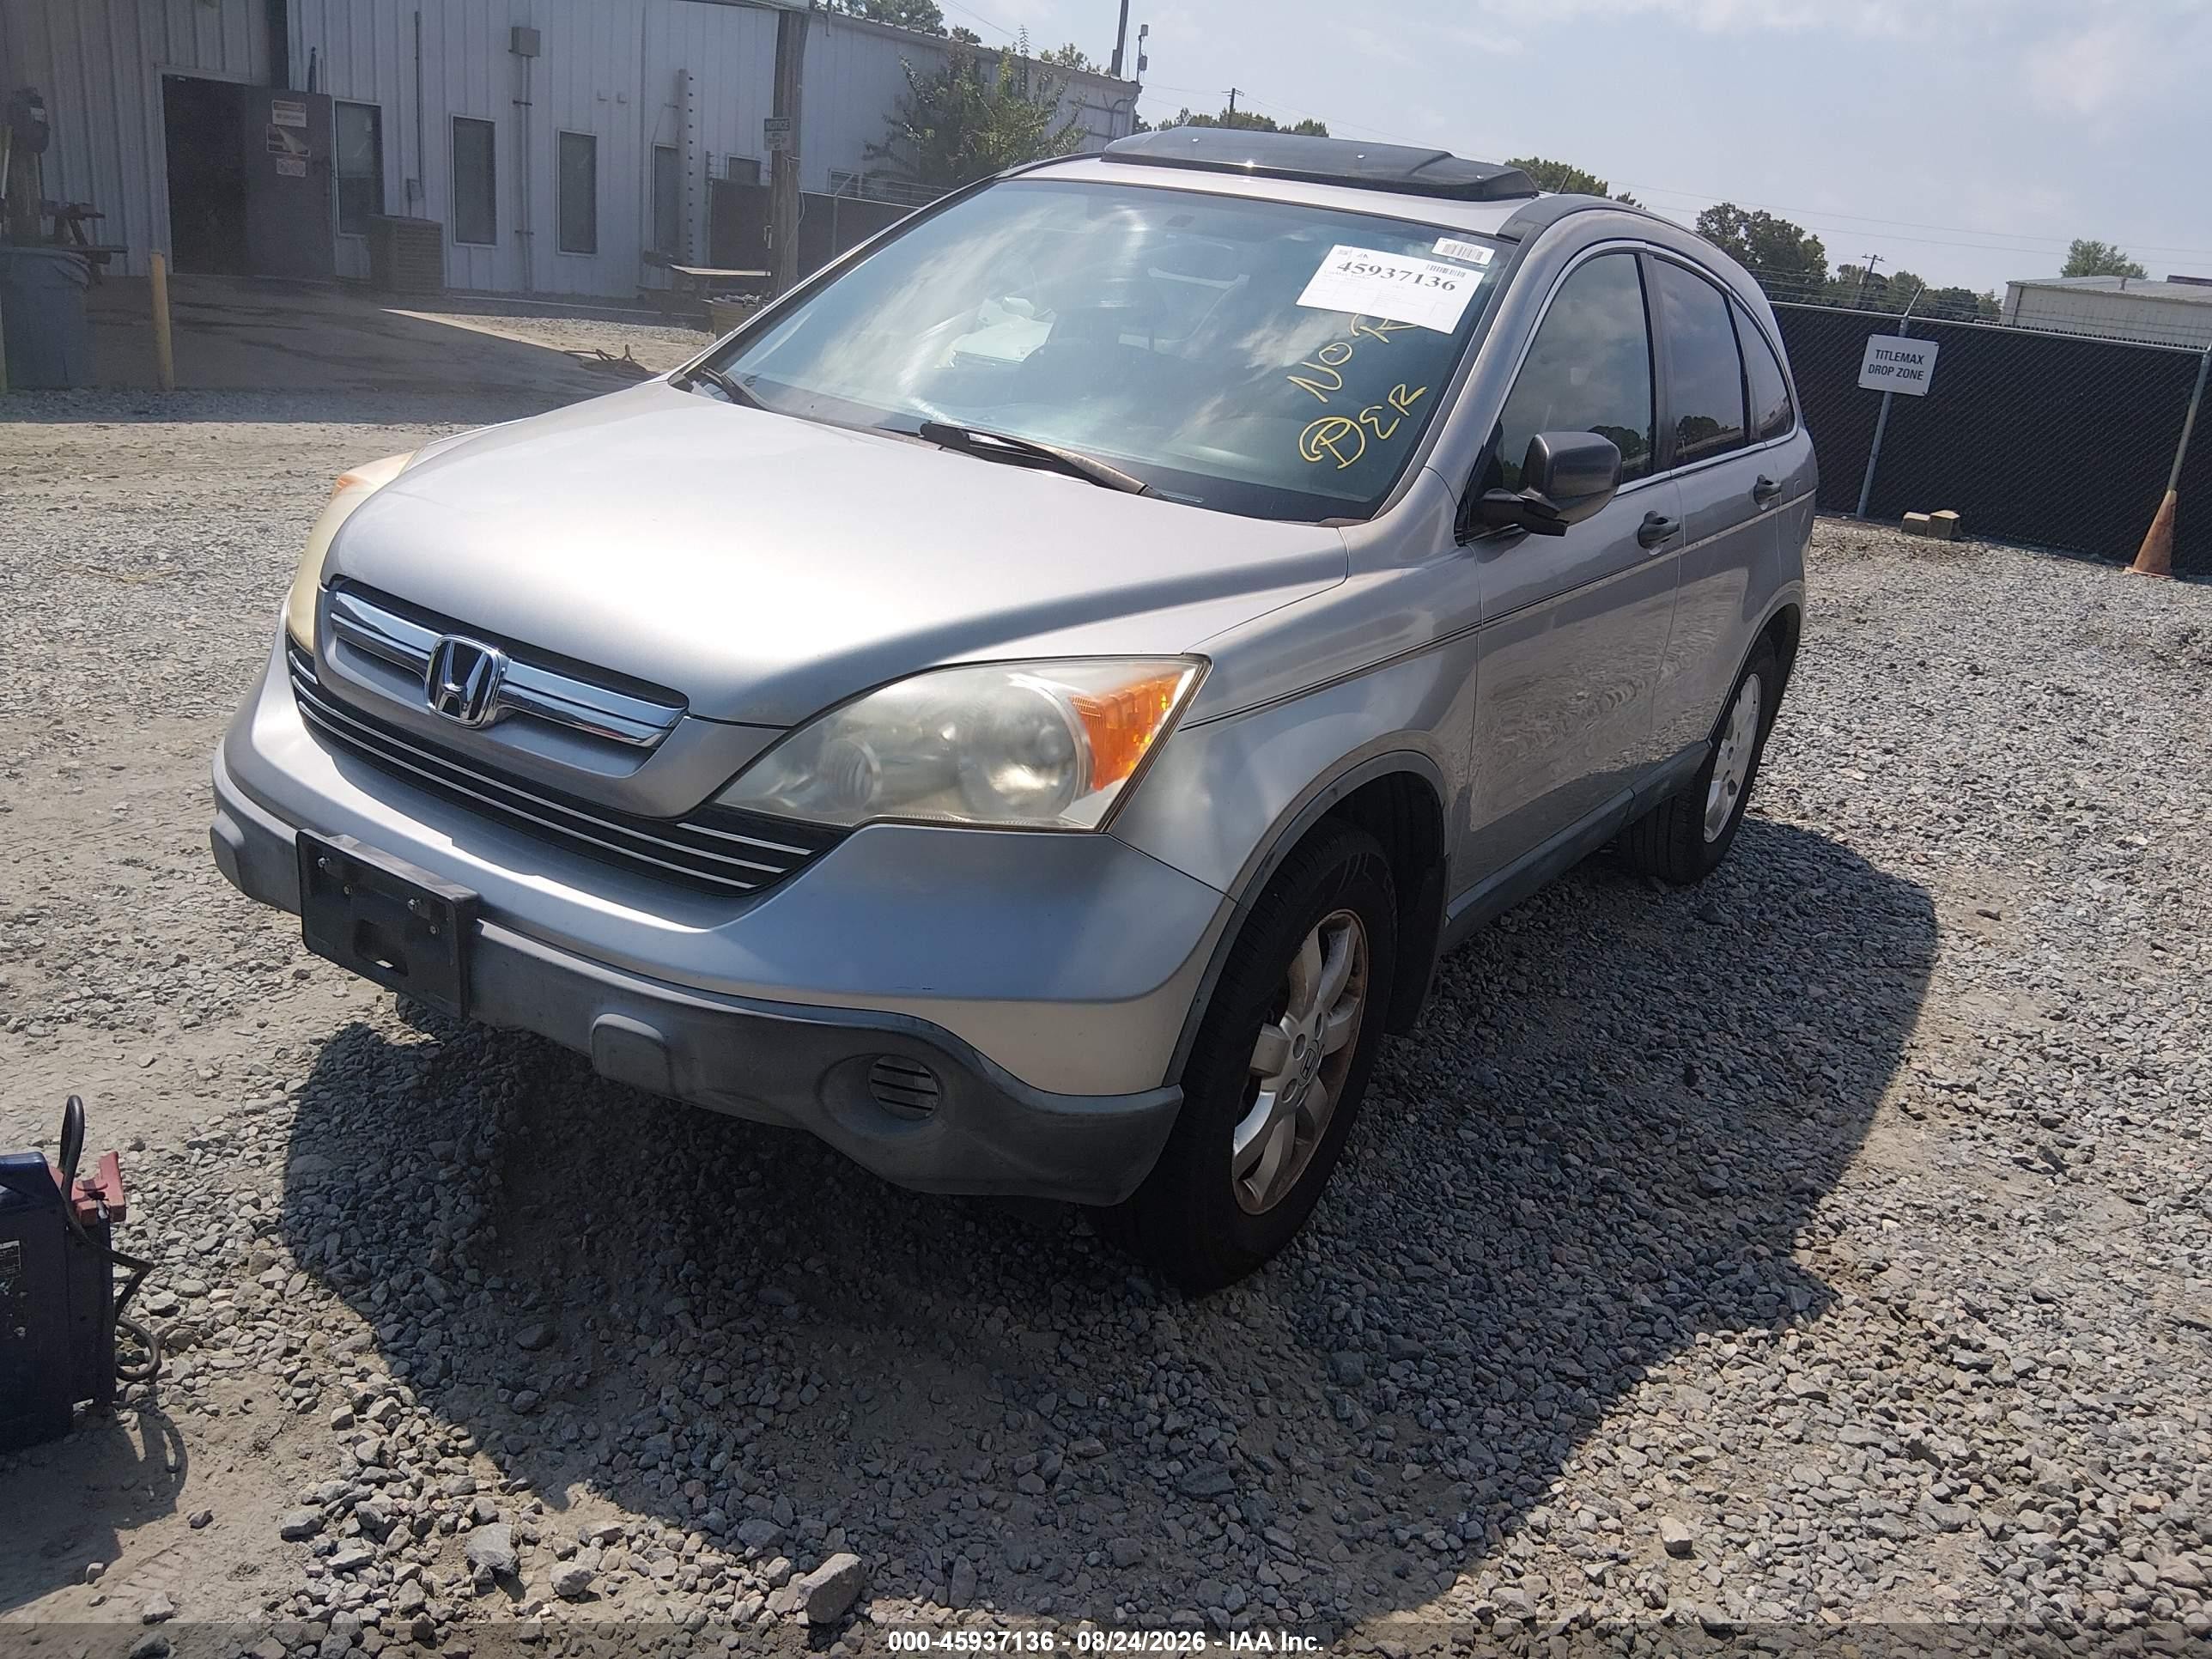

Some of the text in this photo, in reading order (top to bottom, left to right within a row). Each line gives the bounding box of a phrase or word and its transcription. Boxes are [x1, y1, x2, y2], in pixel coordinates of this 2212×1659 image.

[1336, 261, 1457, 292] 45937136
[1875, 349, 1925, 365] TITLEMAX
[1868, 363, 1924, 380] DROP ZONE
